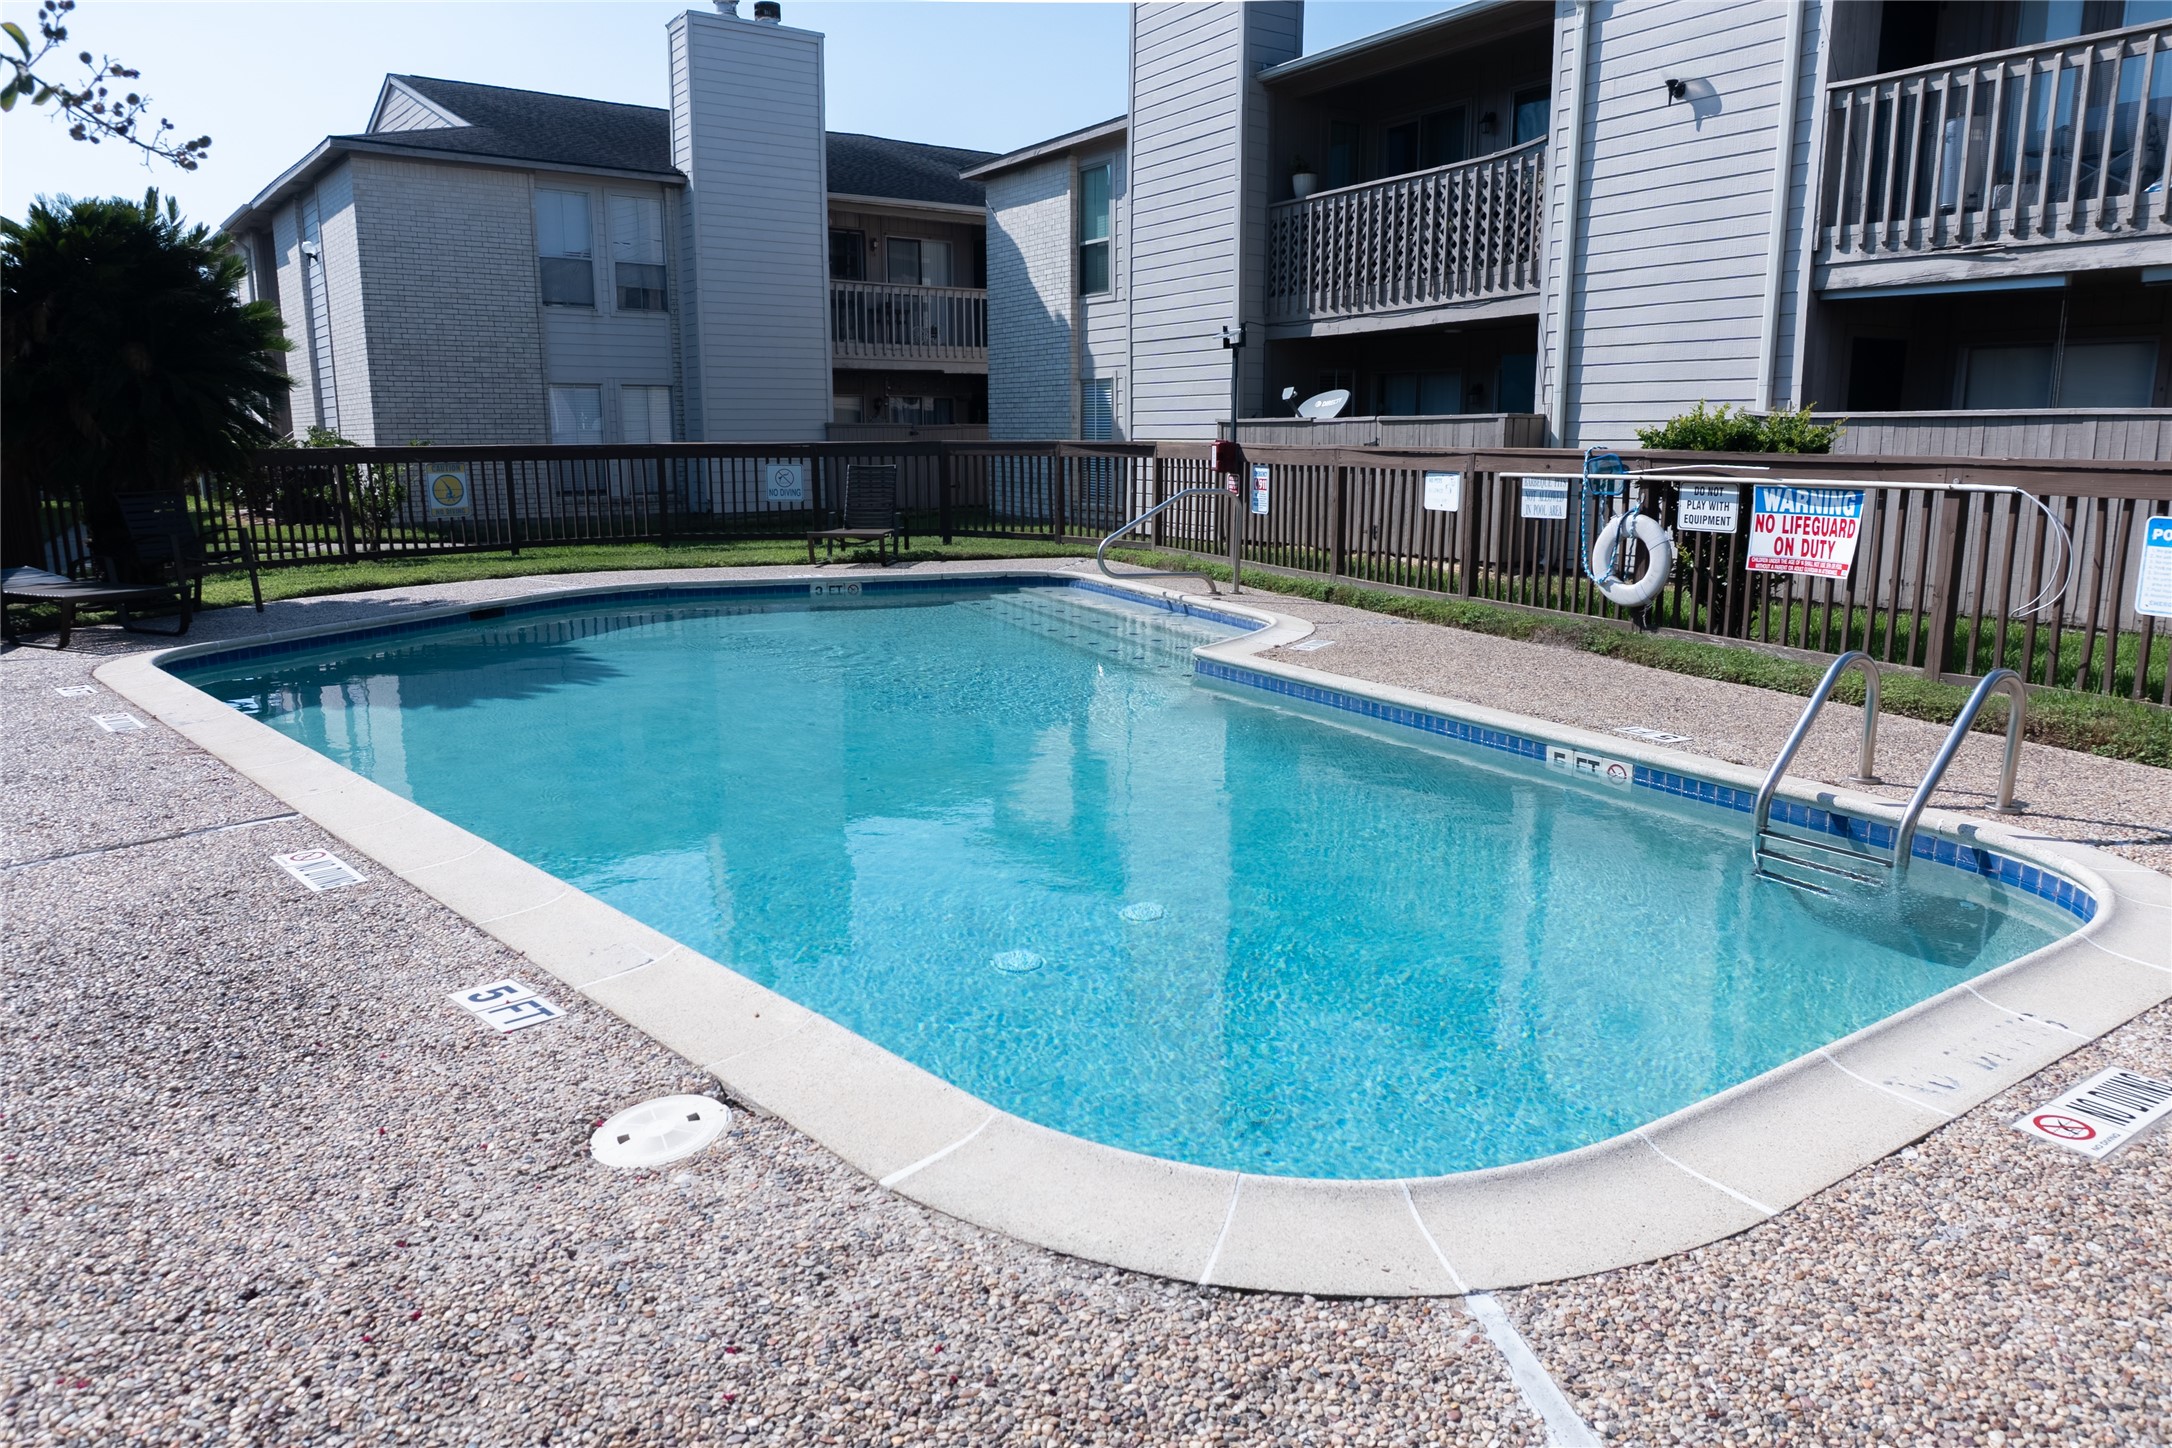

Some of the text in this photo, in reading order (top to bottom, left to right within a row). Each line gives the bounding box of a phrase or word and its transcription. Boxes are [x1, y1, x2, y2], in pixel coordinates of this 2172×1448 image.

[432, 464, 461, 472] CAUTION
[1258, 479, 1267, 490] 911
[769, 488, 801, 497] NO DIVING
[1525, 490, 1565, 502] NOT ALLOWED
[1694, 486, 1725, 497] DO NOT
[1686, 500, 1730, 512] PLAY WITH
[1763, 488, 1856, 516] WARNING
[1525, 504, 1562, 516] IN POOL AREA
[1684, 514, 1731, 527] EQUIPMENT
[1755, 513, 1856, 539] NO LIFEGUARD
[1773, 537, 1836, 560] ON DUTY
[468, 985, 556, 1025] 5 FT
[2065, 1072, 2172, 1127] NO DIVING
[2091, 1132, 2121, 1152] NO DIVING
